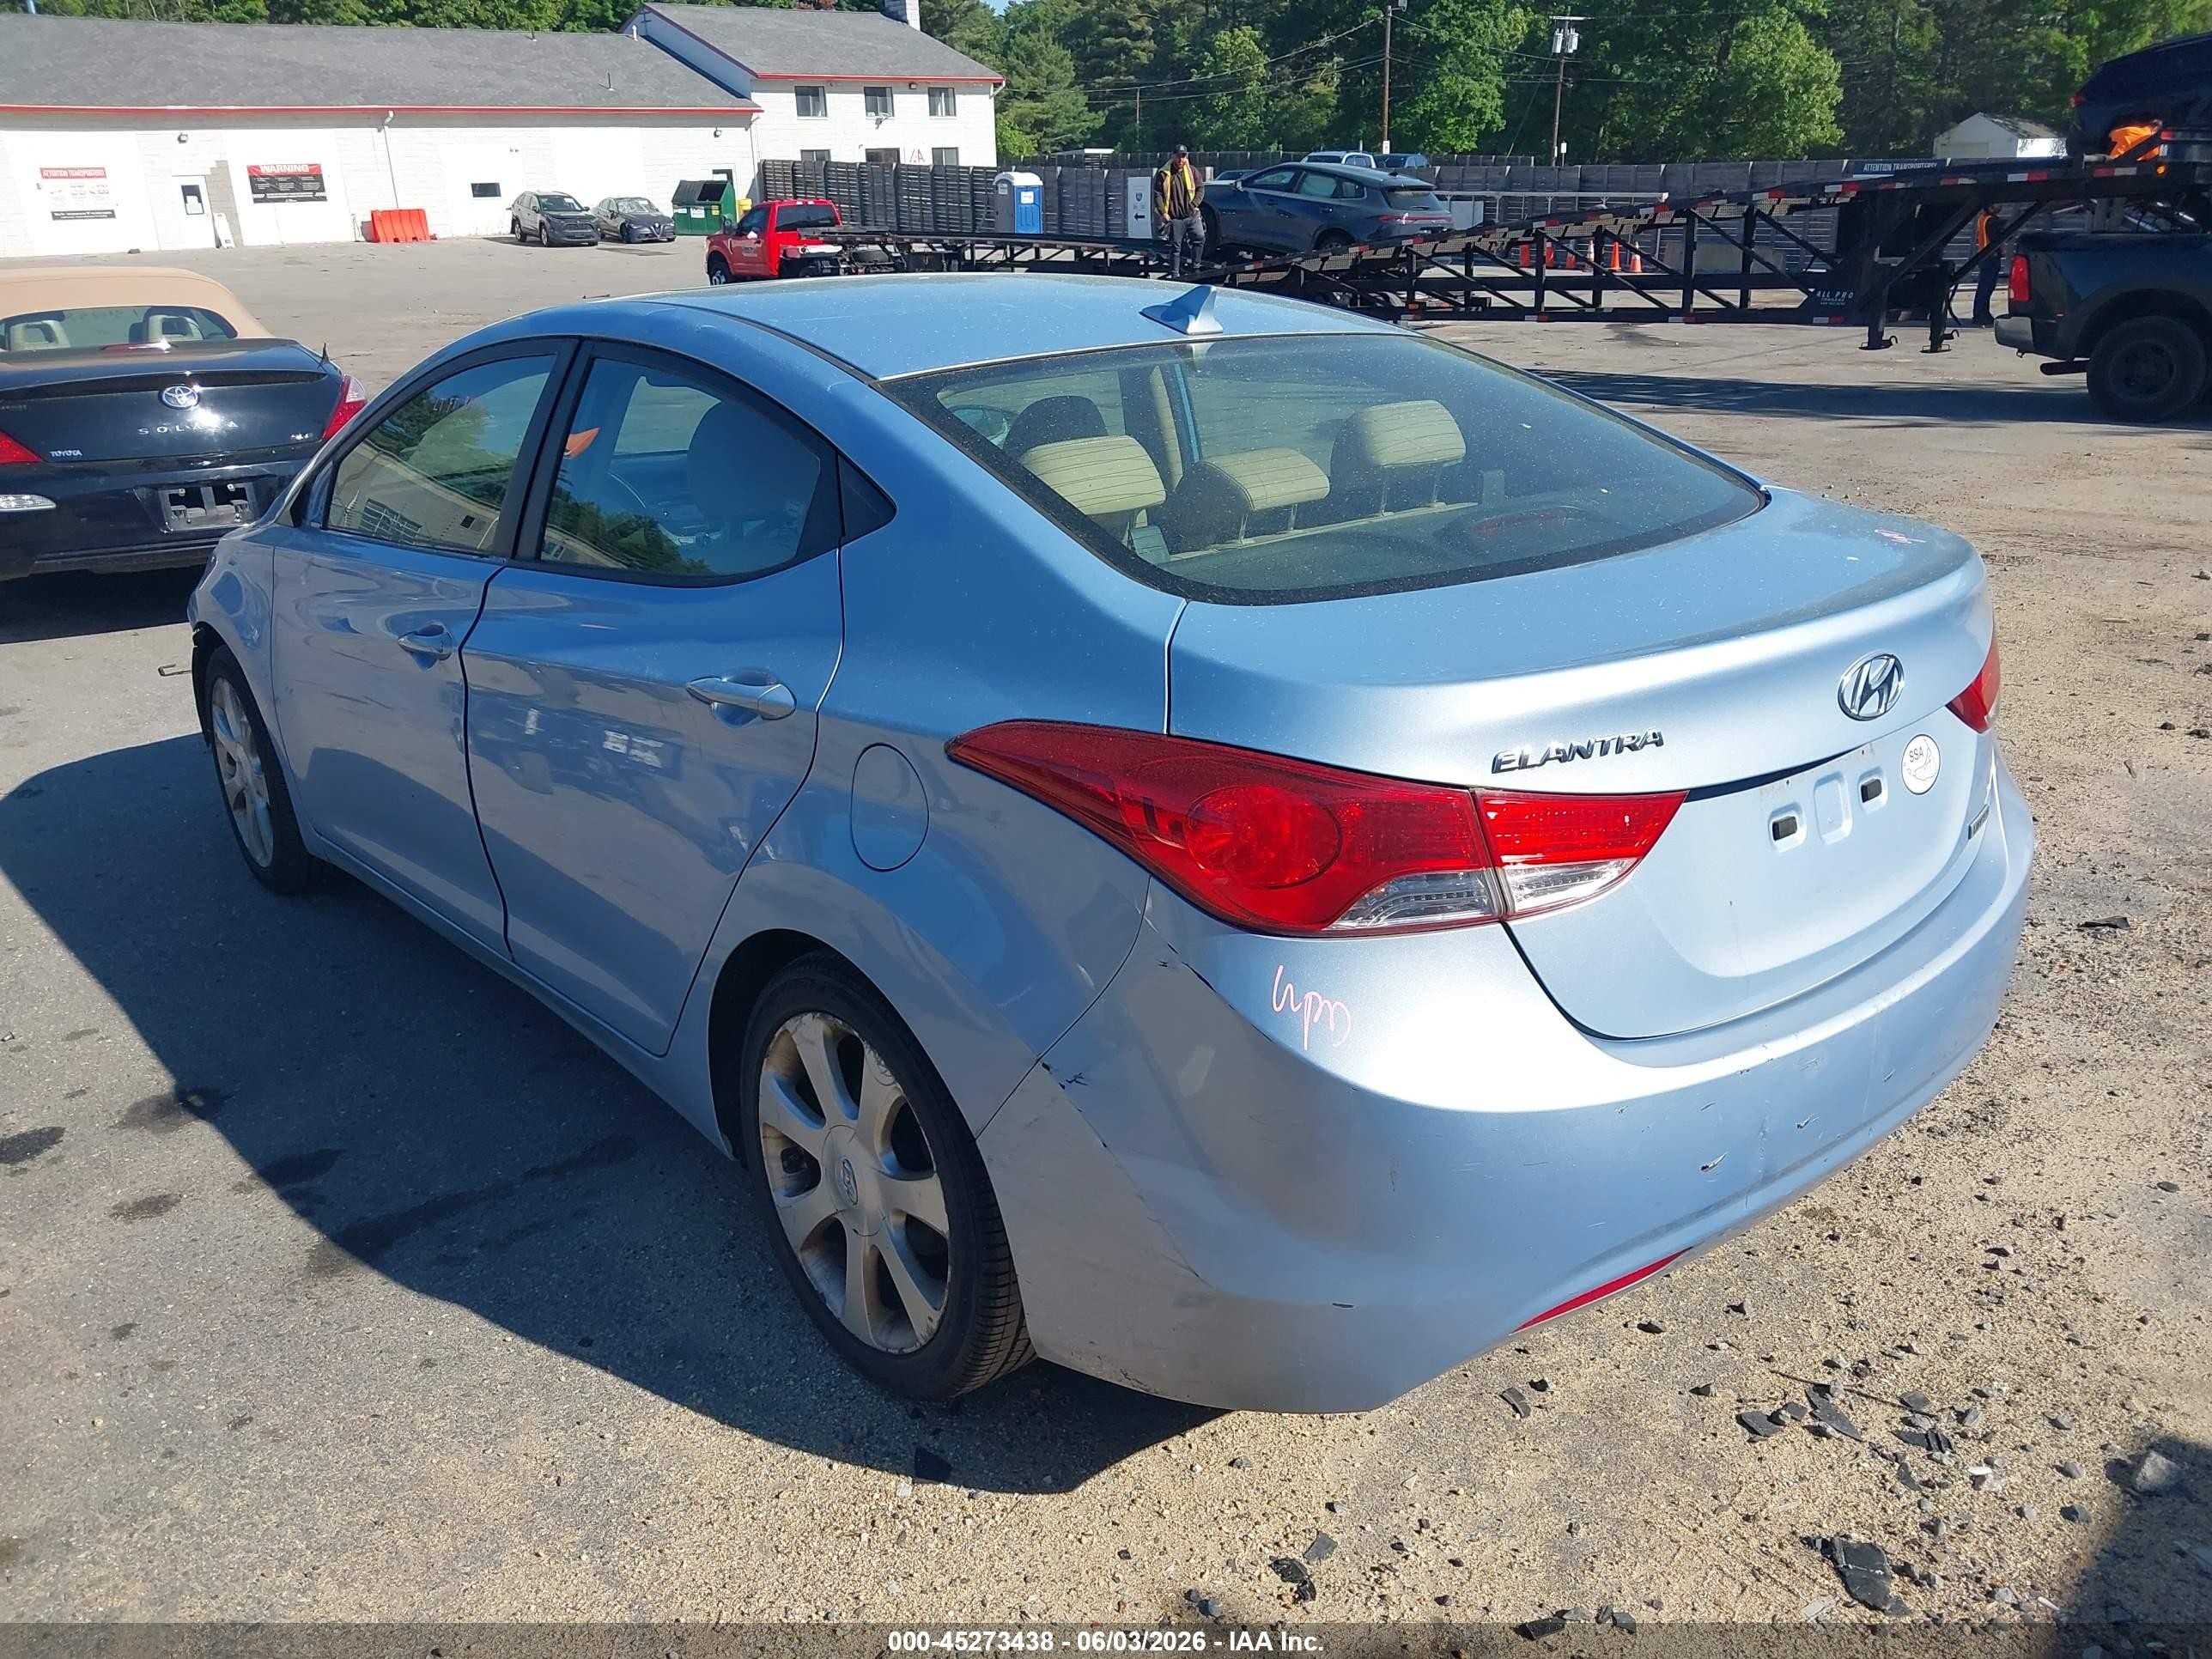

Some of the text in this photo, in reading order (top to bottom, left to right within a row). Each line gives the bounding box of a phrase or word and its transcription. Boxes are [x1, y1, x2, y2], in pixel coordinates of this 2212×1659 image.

[259, 164, 310, 173] WARNING
[1863, 162, 1892, 173] ATTENTION
[49, 449, 83, 458] TOYOTA
[1491, 726, 1665, 775] ELANTRA
[1909, 746, 1924, 763] SSA
